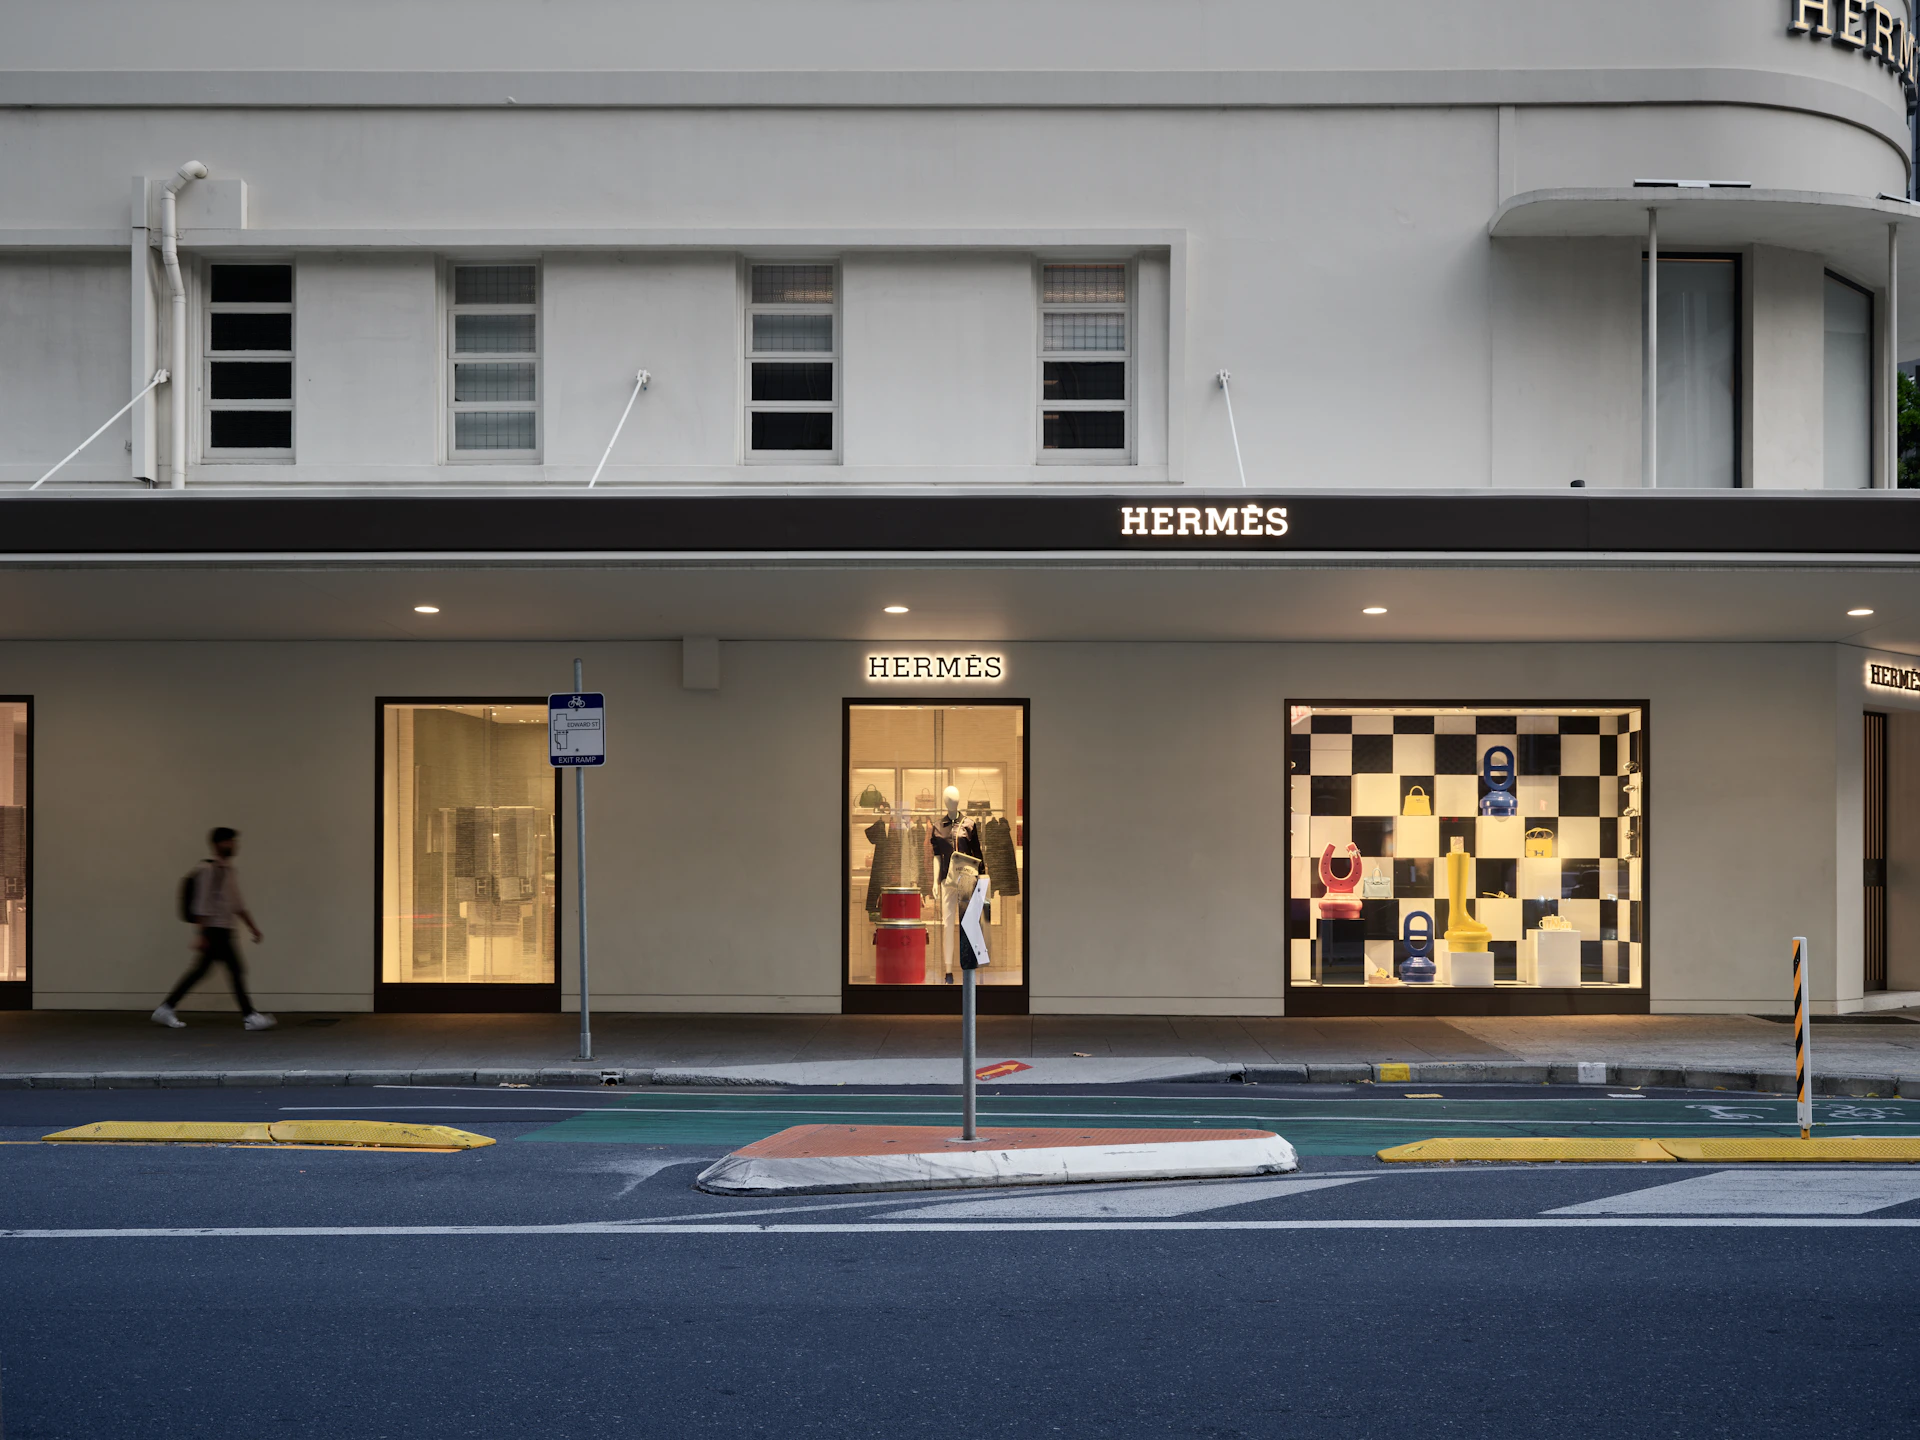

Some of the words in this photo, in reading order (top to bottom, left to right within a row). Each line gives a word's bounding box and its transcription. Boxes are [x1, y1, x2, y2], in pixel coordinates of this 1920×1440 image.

[1788, 0, 1920, 86] HERM
[1121, 504, 1288, 536] HERMÈS
[868, 654, 1001, 678] HERMÈS
[558, 756, 574, 764] EXIT
